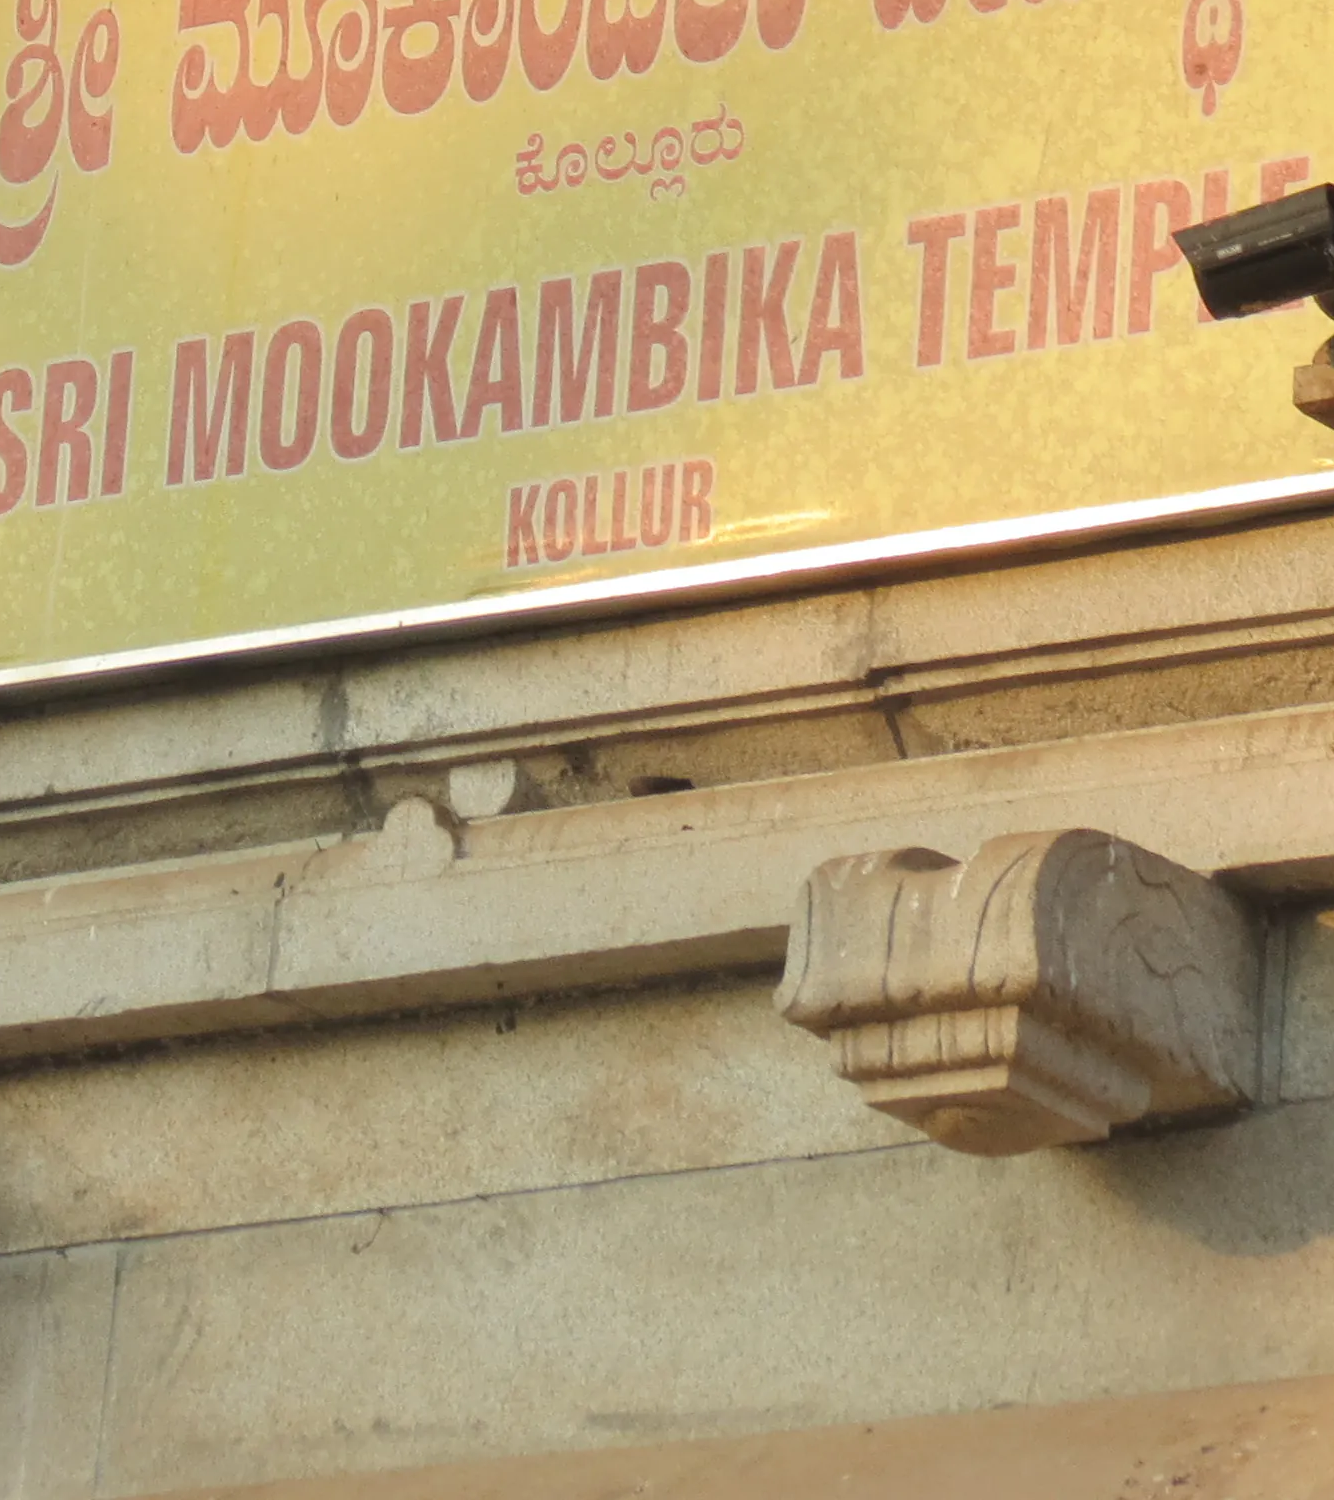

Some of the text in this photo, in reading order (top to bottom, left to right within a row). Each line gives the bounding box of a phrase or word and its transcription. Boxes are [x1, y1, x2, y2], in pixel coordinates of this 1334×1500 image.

[515, 102, 746, 201] ಕೊಲ್ಲೂರು
[164, 229, 867, 488] MOOKAMBIKA
[505, 458, 716, 569] KOLLUR
